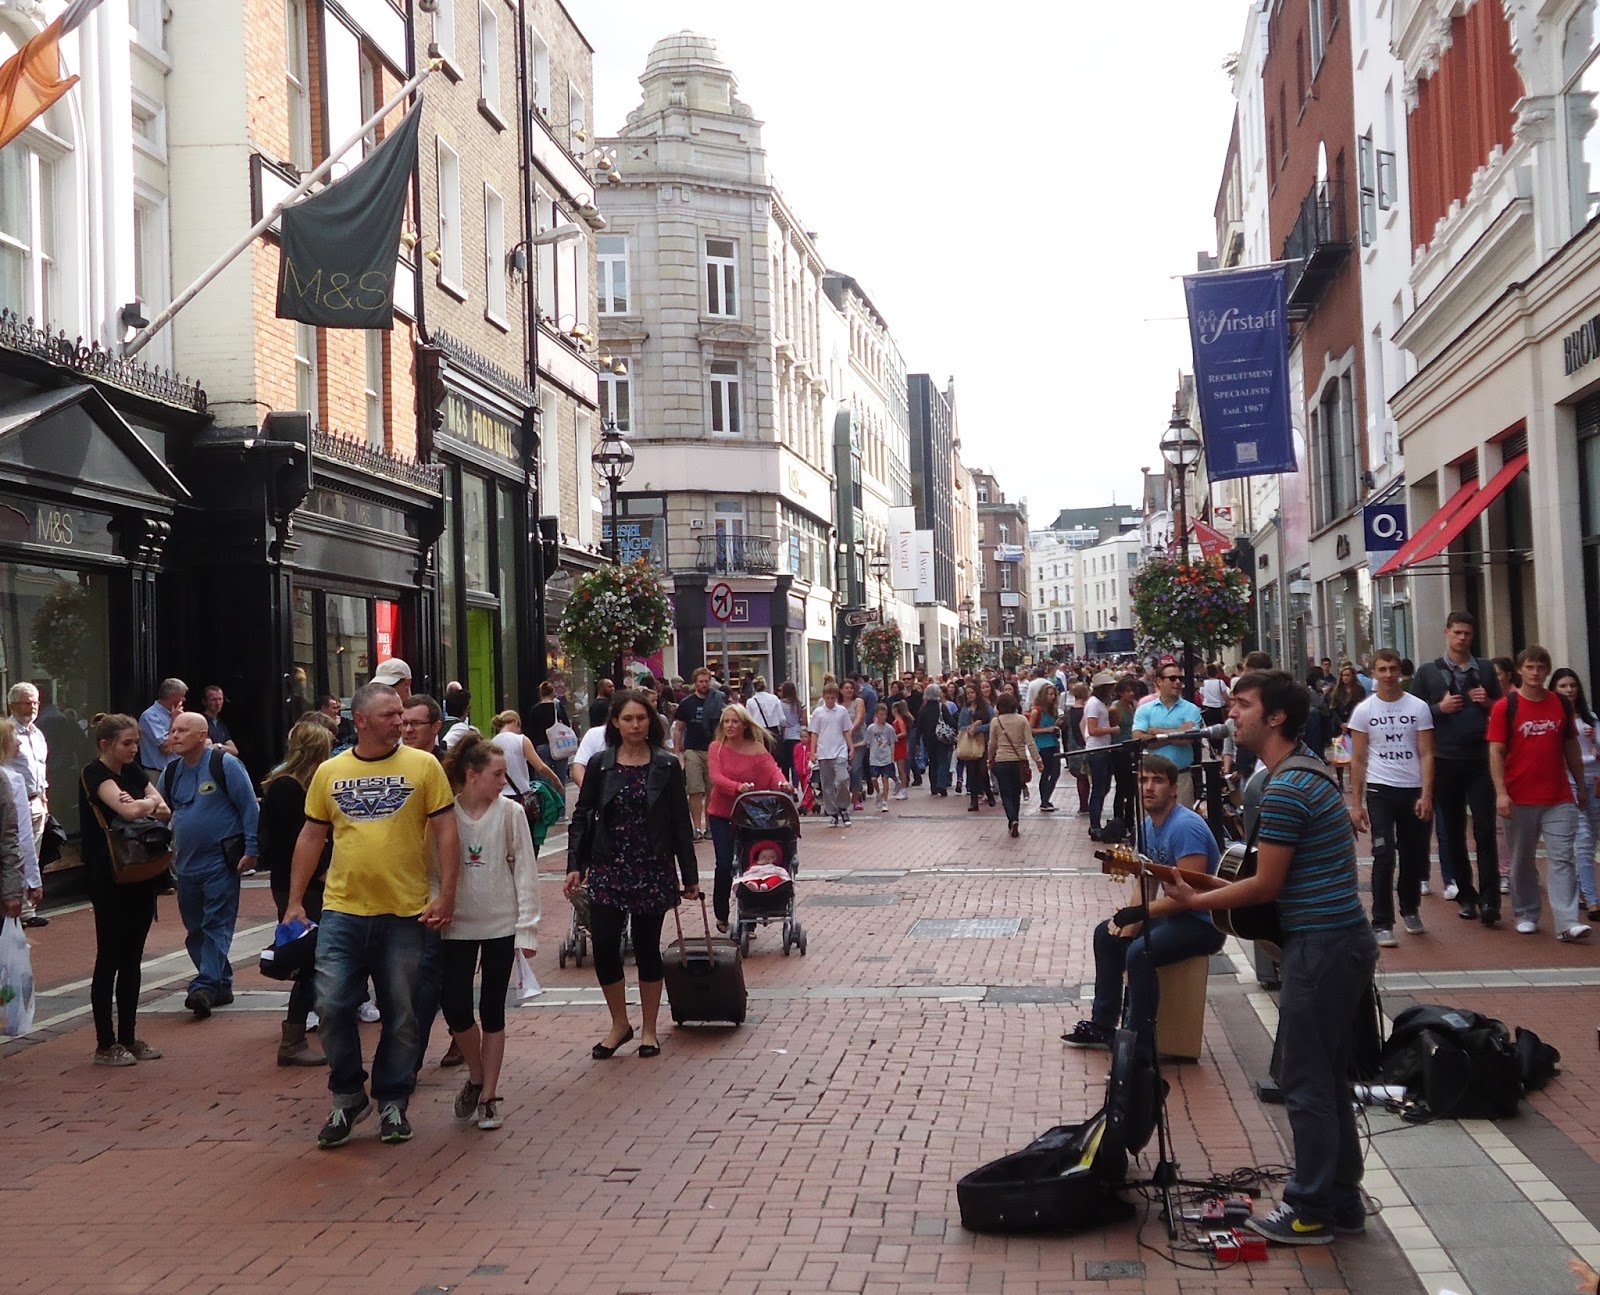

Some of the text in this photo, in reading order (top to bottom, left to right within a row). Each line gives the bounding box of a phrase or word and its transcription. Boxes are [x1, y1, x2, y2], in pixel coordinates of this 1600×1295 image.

[283, 257, 388, 310] M&S
[1200, 308, 1277, 345] firstaff
[1208, 369, 1274, 383] RECRUITMENT
[1213, 387, 1271, 400] SPECIALISTS
[1244, 403, 1264, 414] 1967
[448, 396, 513, 459] M&S FOOD HALL
[38, 509, 73, 545] M&S
[1369, 715, 1417, 726] OUT OF
[1386, 733, 1404, 742] MY
[1379, 751, 1414, 760] MIND
[332, 775, 413, 791] DIESEL
